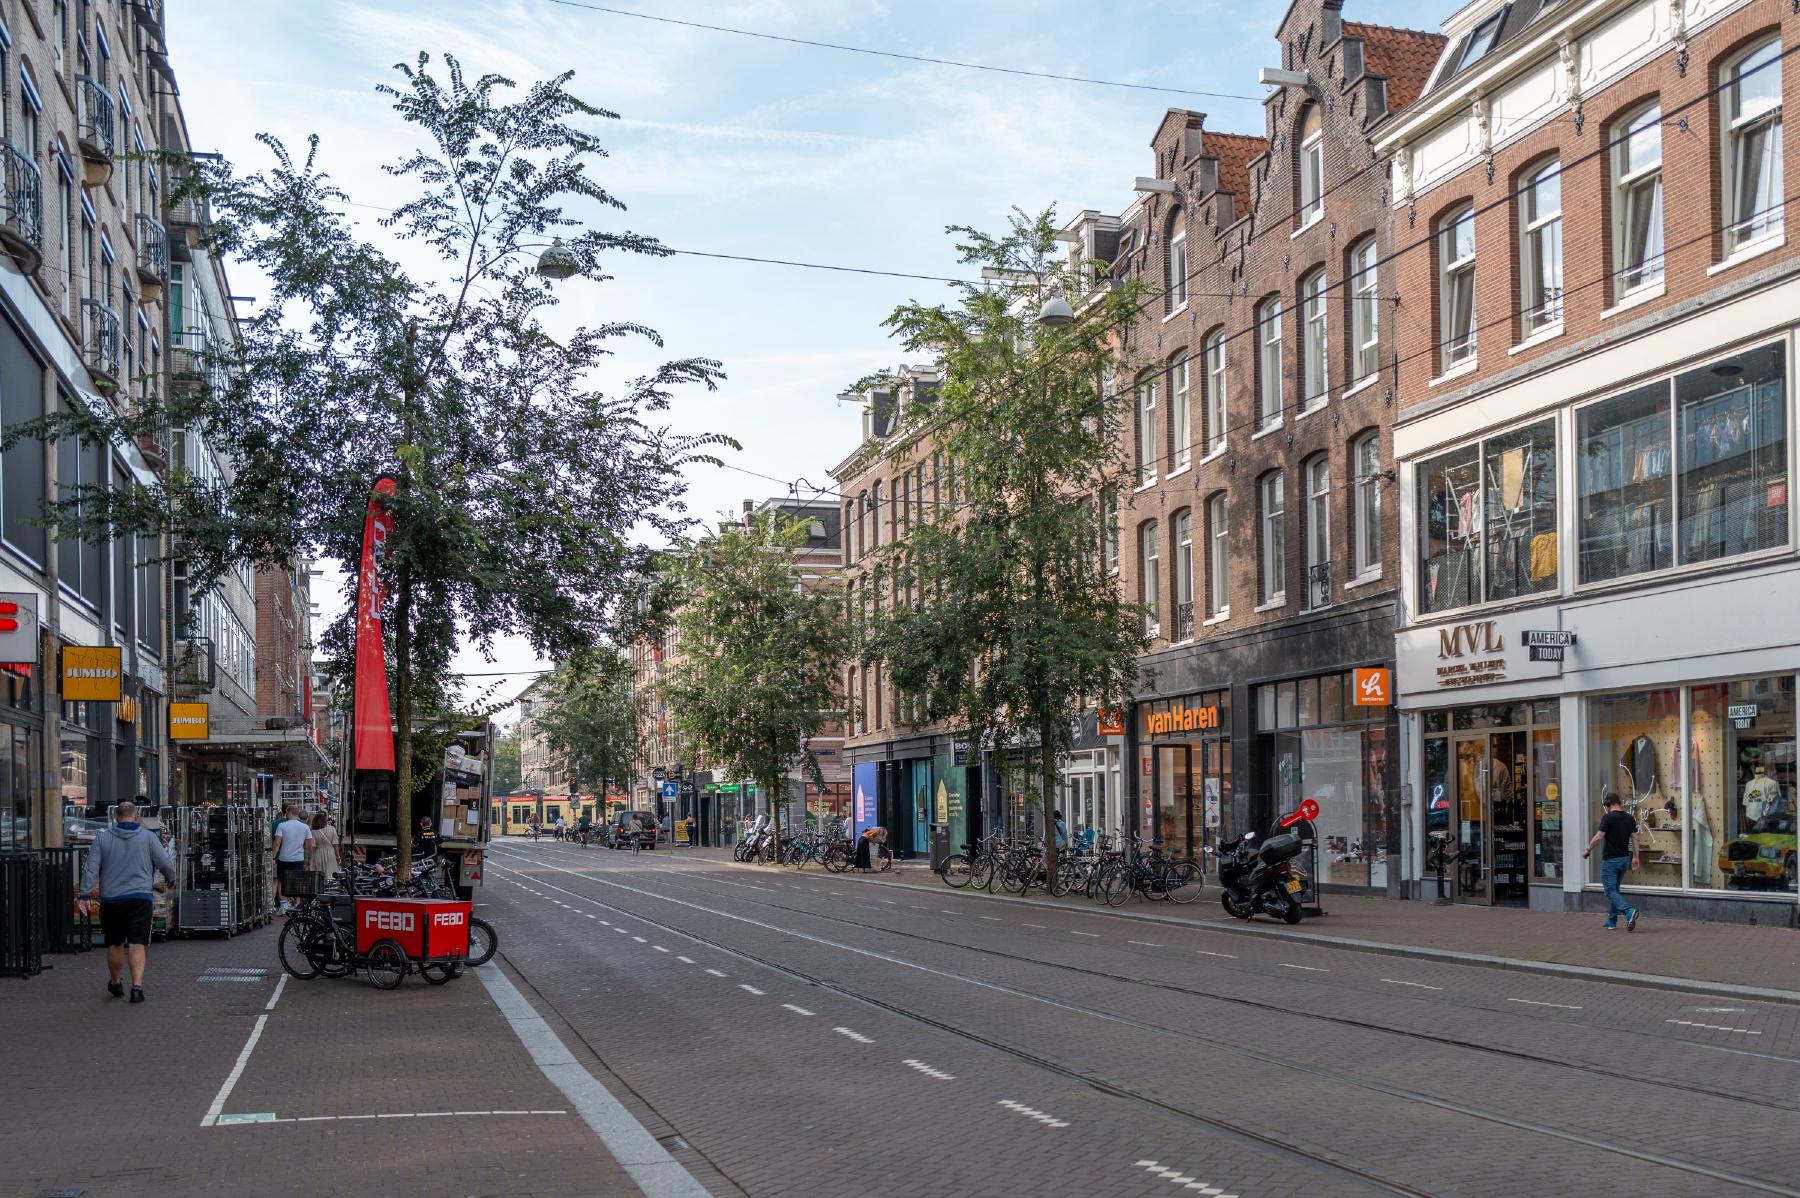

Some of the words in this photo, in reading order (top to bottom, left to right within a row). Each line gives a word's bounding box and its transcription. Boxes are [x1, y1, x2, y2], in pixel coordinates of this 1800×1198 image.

[1438, 620, 1504, 659] MVL
[1530, 631, 1570, 646] AMERICA
[1538, 647, 1562, 660] TODAY
[66, 667, 118, 679] JUMBO
[115, 693, 135, 724] JUMBO
[1729, 705, 1756, 718] AMERICA
[172, 716, 206, 725] JUMBO
[1147, 705, 1218, 734] vanHaren
[1735, 719, 1751, 729] TODAY
[365, 910, 415, 931] FEBO
[434, 912, 464, 926] FEBO
